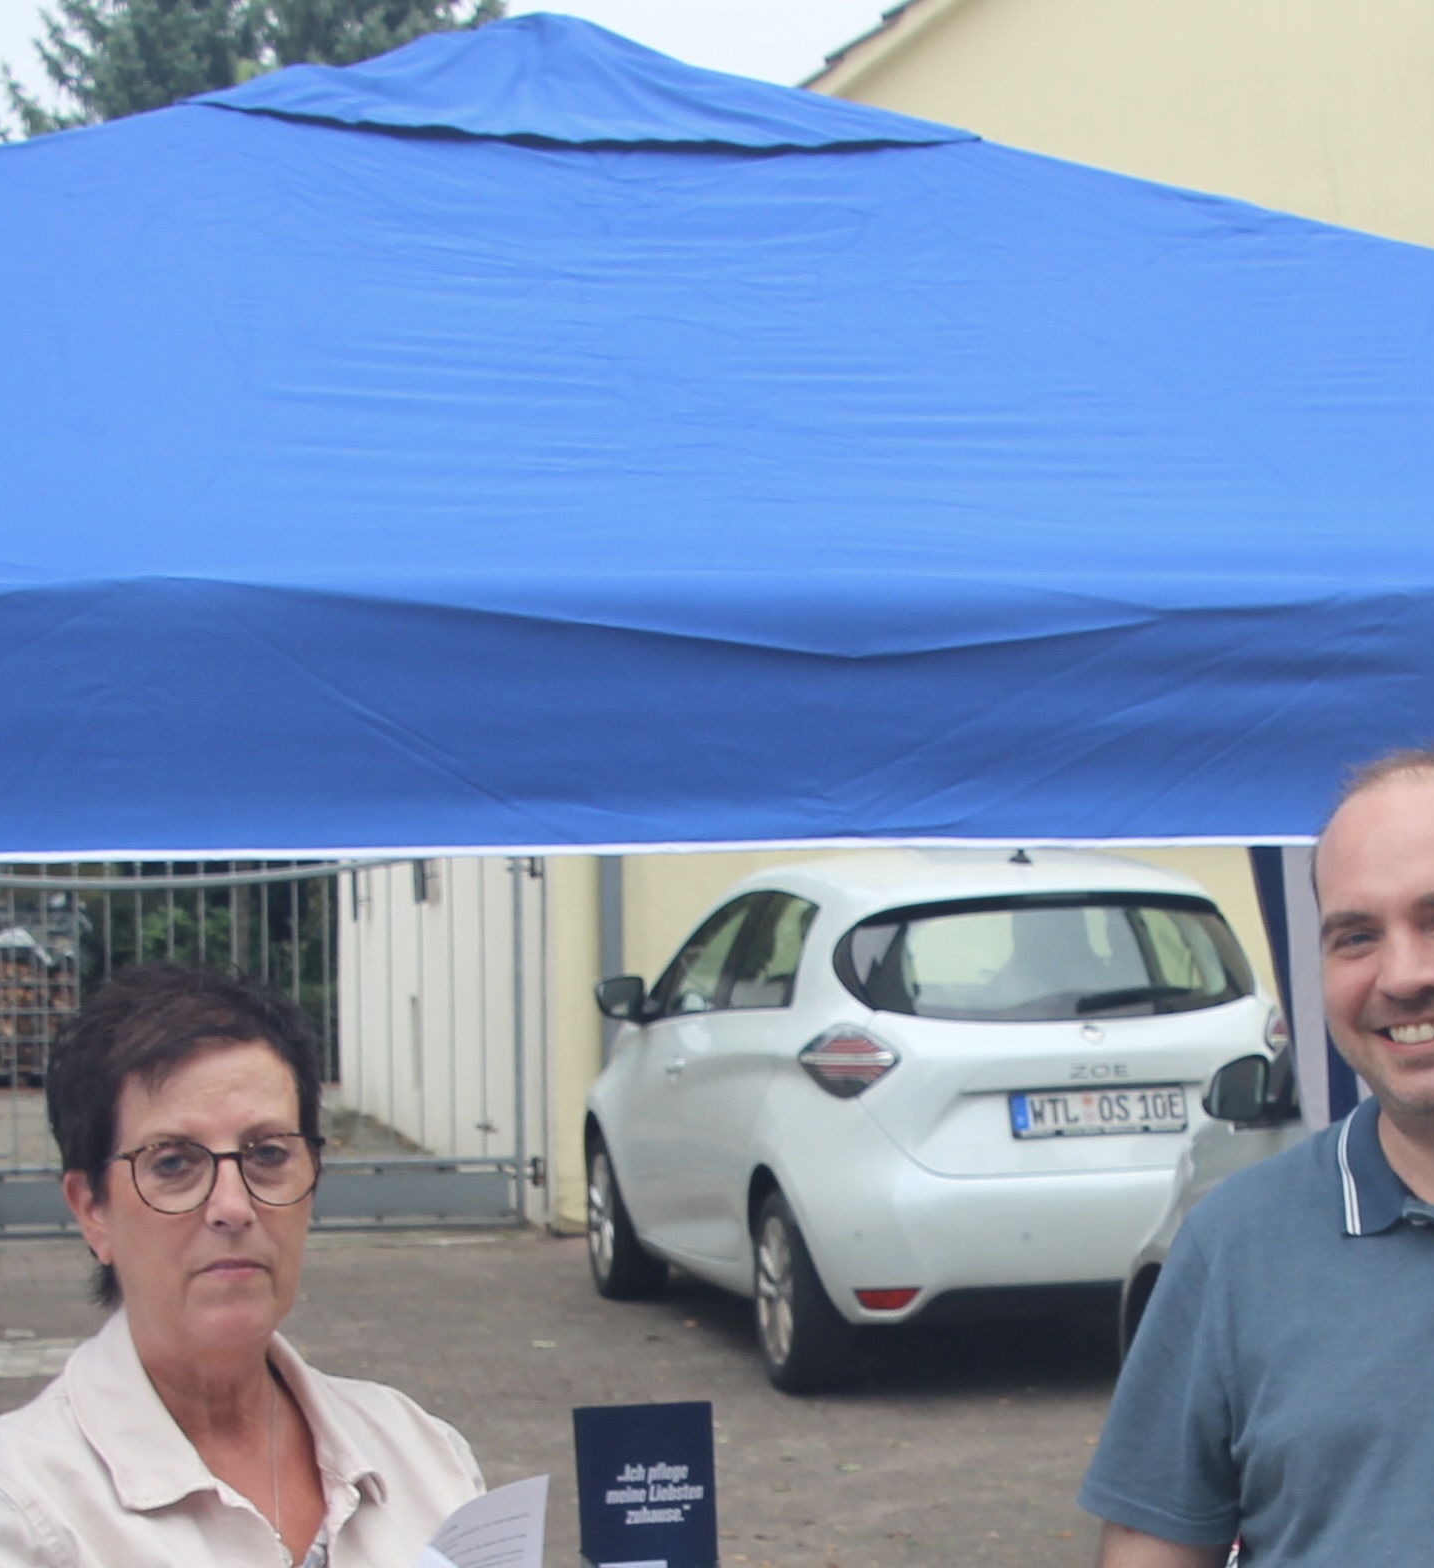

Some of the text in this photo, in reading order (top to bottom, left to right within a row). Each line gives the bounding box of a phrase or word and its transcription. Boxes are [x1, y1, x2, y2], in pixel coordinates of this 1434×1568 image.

[1070, 1064, 1129, 1079] ZOE
[1030, 1092, 1185, 1125] WTL OS 10E
[647, 1462, 689, 1485] pflege
[605, 1484, 704, 1504] meine Liebsten
